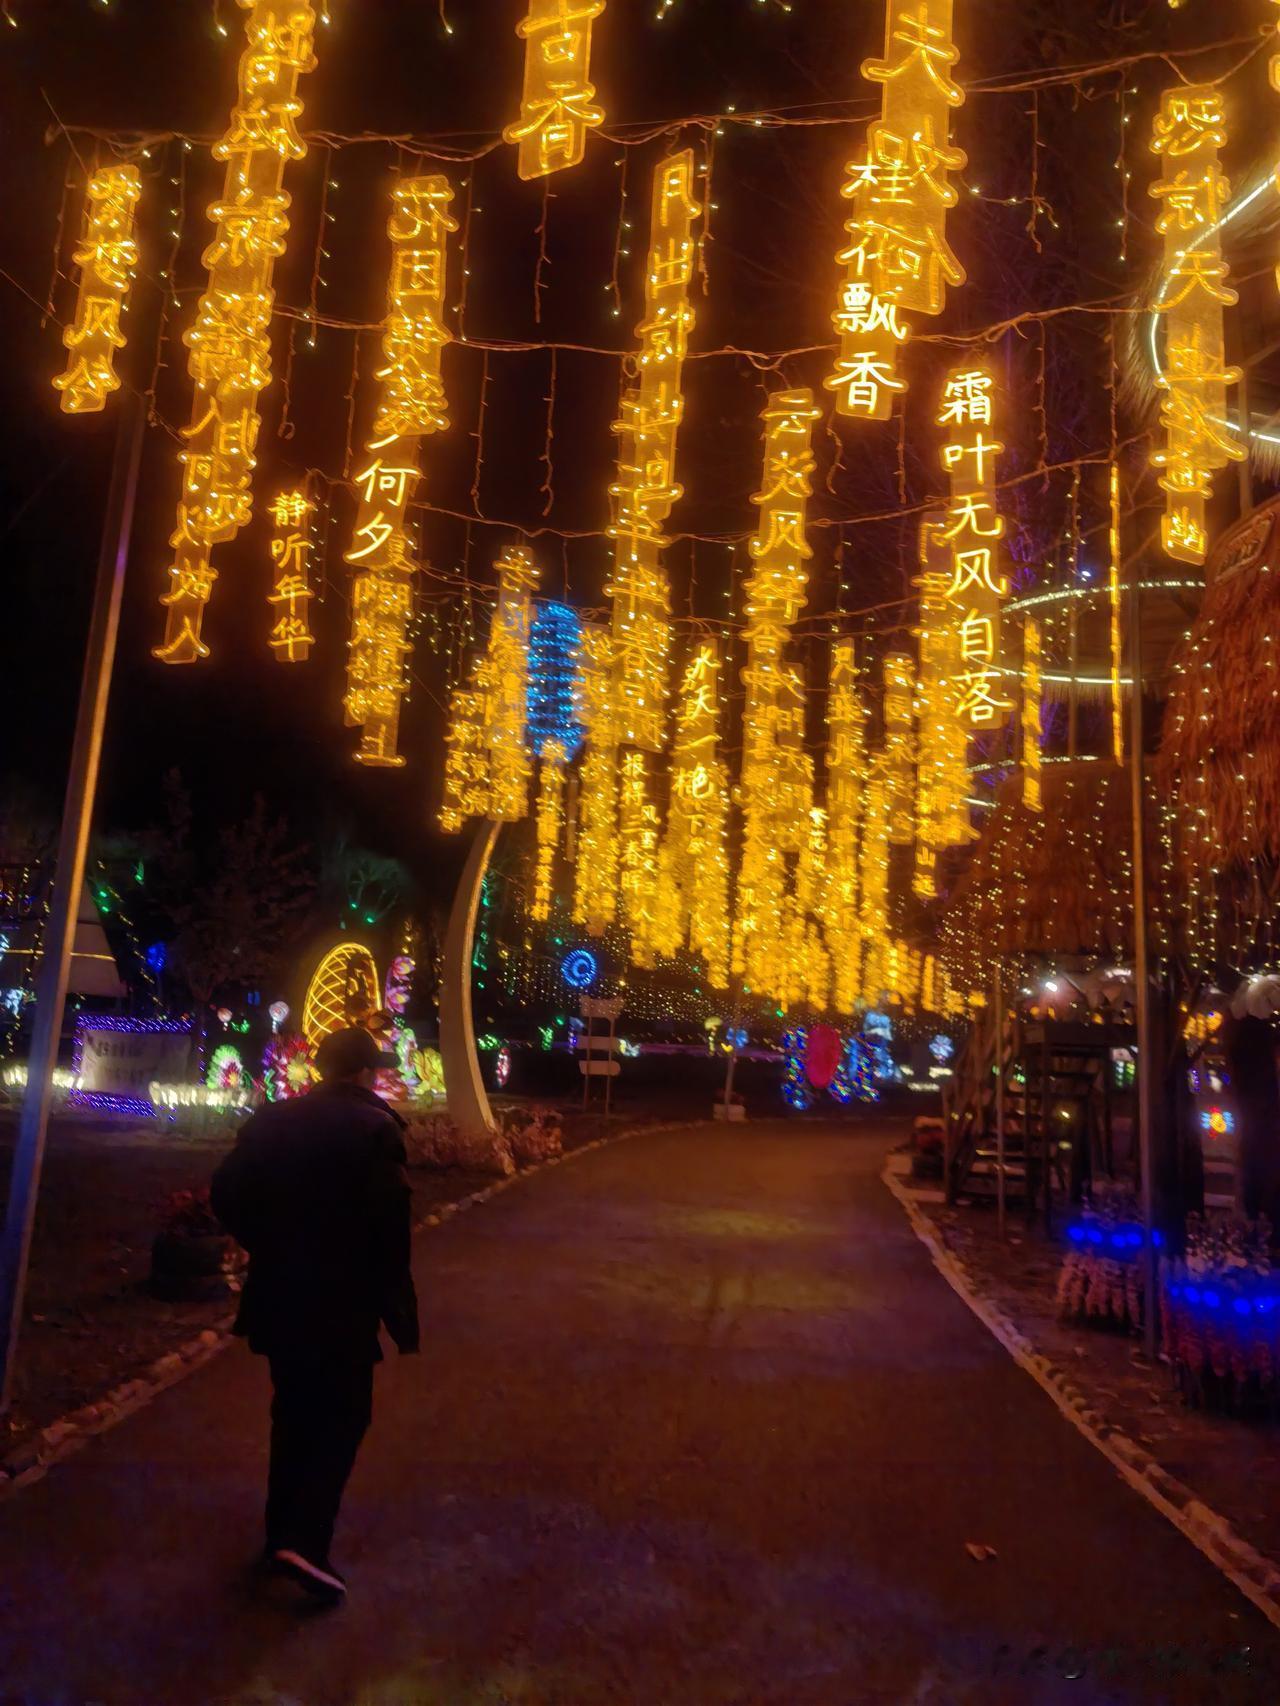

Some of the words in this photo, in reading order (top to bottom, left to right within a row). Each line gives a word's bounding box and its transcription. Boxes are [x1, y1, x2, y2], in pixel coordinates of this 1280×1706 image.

[830, 152, 911, 413] 桂花飘香
[268, 491, 315, 661] 静听年华
[938, 373, 1012, 722] 霜叶无风自落
